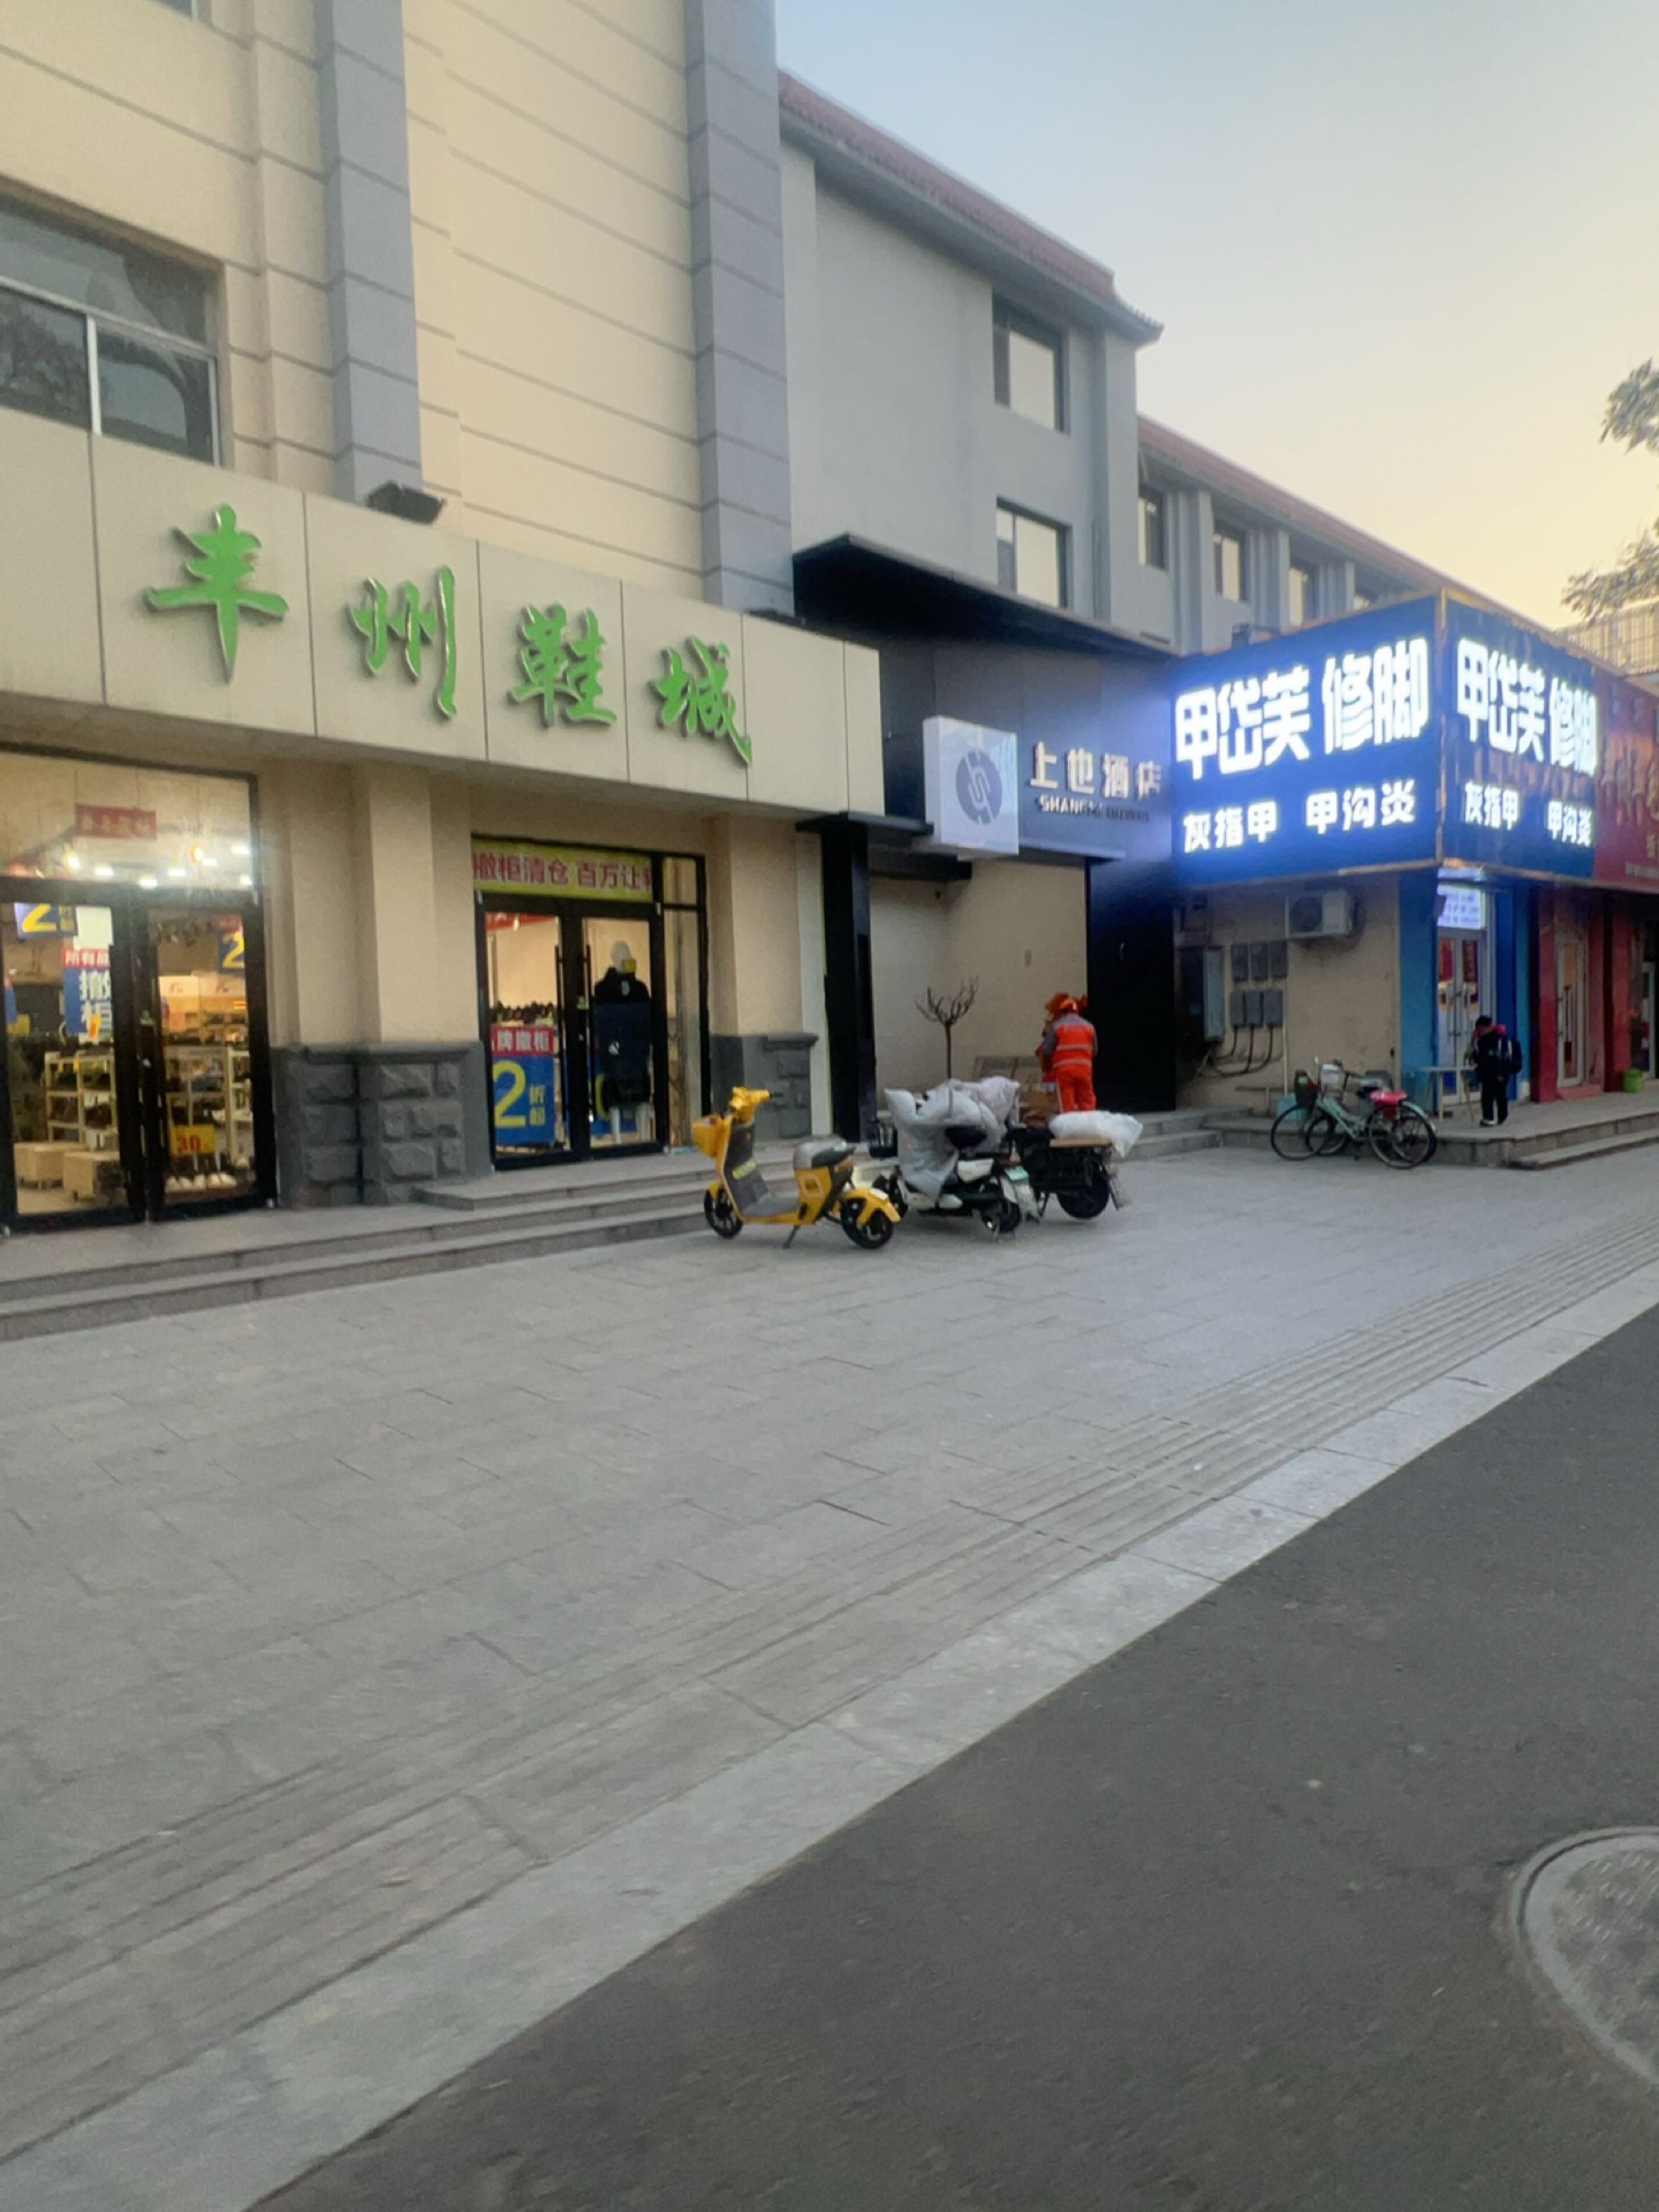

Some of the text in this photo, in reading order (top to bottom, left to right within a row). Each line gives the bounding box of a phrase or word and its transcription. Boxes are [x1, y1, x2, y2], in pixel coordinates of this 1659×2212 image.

[142, 502, 753, 765] 丰州鞋城
[1321, 637, 1428, 755] 修脚
[1029, 741, 1162, 800] 上也酒店
[1182, 779, 1416, 853] 灰指甲 甲沟炎
[1464, 780, 1519, 831] 灰指甲
[491, 1030, 550, 1052] 牌撤柜
[492, 1060, 527, 1127] 2
